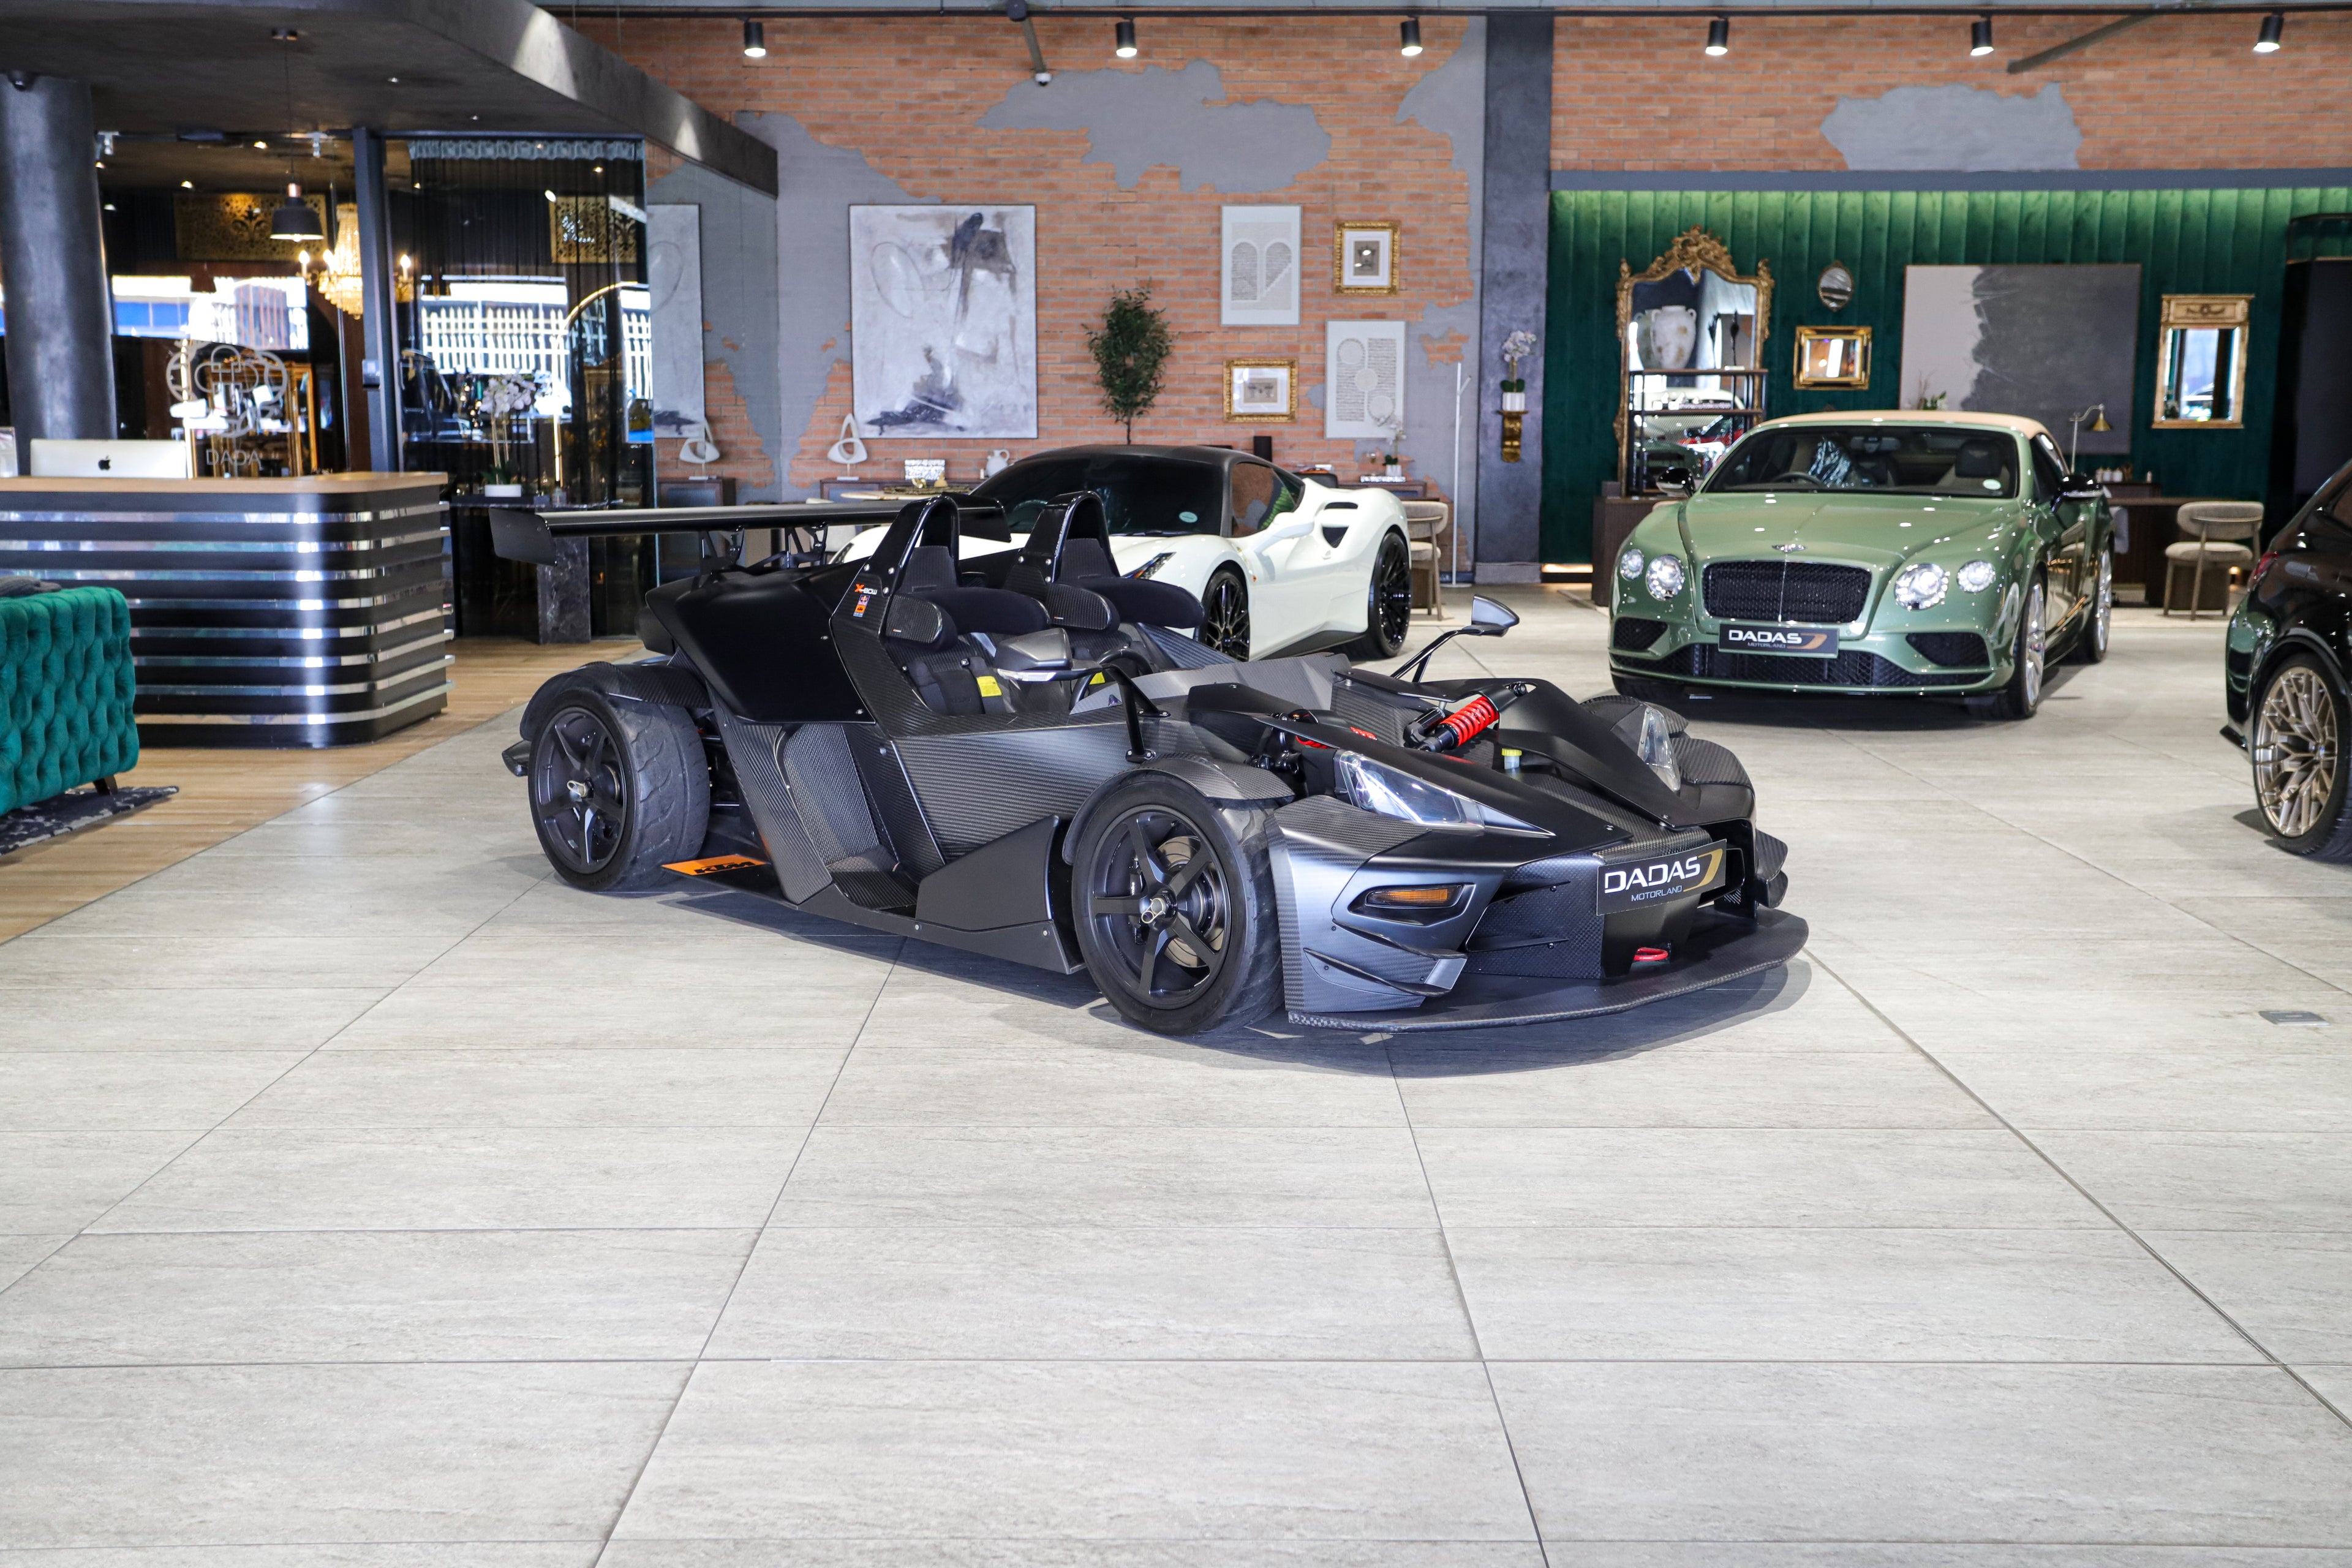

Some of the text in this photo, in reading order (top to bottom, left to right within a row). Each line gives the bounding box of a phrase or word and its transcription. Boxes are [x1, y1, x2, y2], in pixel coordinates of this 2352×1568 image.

[854, 584, 878, 595] X-BOW
[1728, 630, 1802, 644] DADAS
[693, 861, 756, 874] KTM
[1604, 856, 1700, 894] DADAS
[1631, 885, 1683, 902] MOTORLAND
